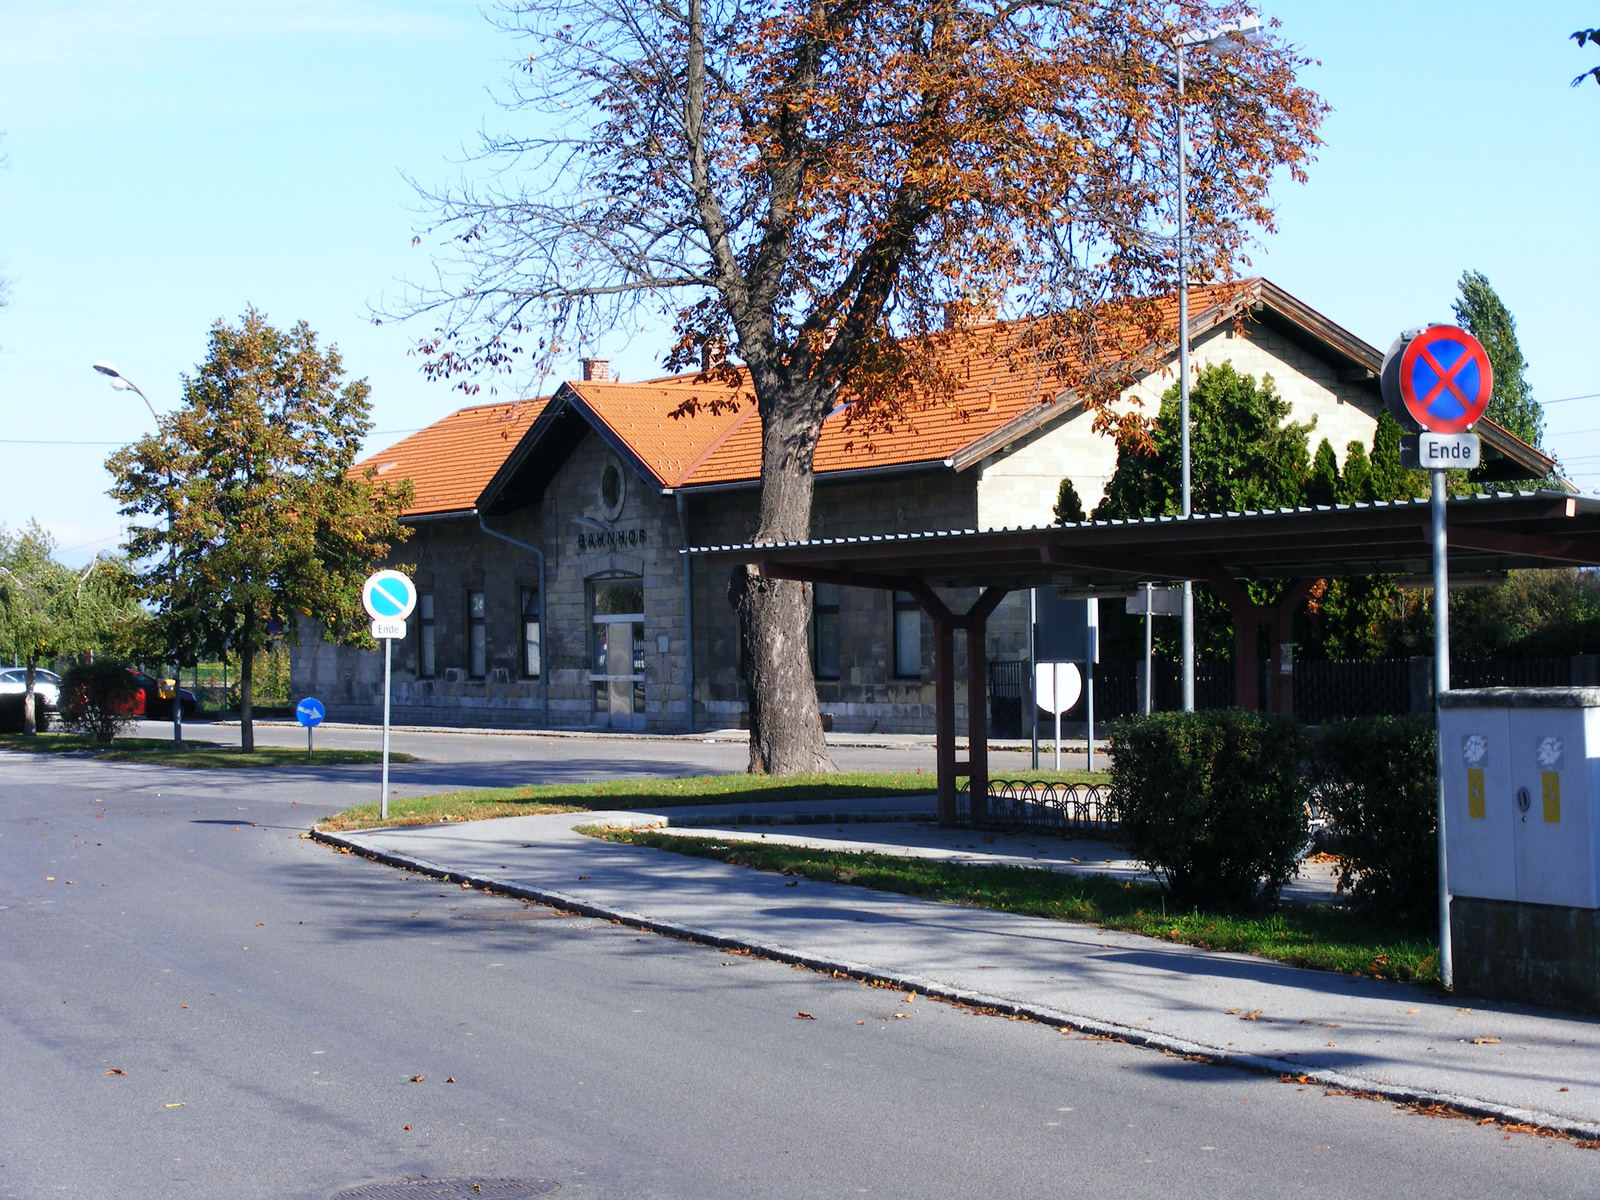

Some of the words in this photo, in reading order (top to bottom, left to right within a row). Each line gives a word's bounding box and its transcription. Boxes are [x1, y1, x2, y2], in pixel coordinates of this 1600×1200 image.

[1429, 442, 1471, 459] Ende
[578, 529, 647, 548] BAHNHOF
[378, 624, 399, 634] Ende
